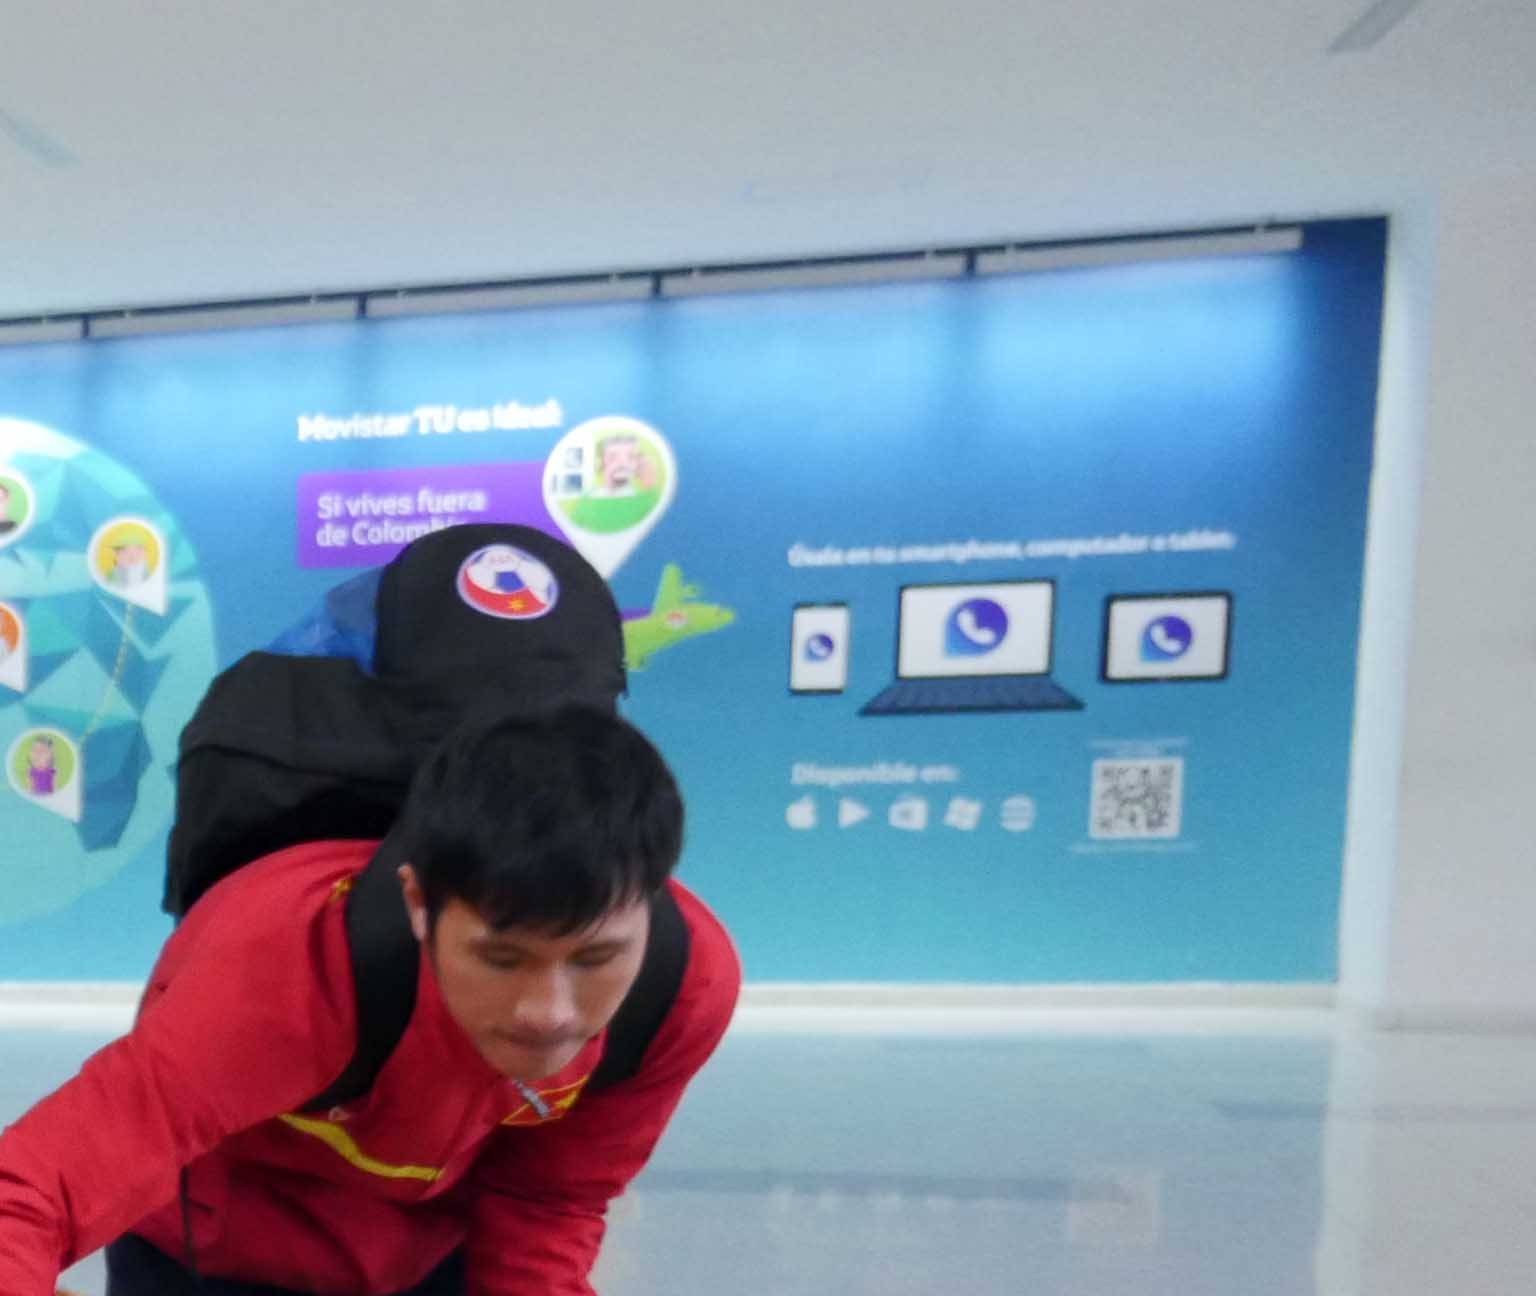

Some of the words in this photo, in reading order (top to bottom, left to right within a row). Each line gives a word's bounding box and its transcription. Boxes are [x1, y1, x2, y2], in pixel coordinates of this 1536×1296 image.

[317, 491, 342, 519] Si
[346, 492, 414, 516] vives
[417, 487, 486, 513] fuera
[316, 521, 348, 547] de
